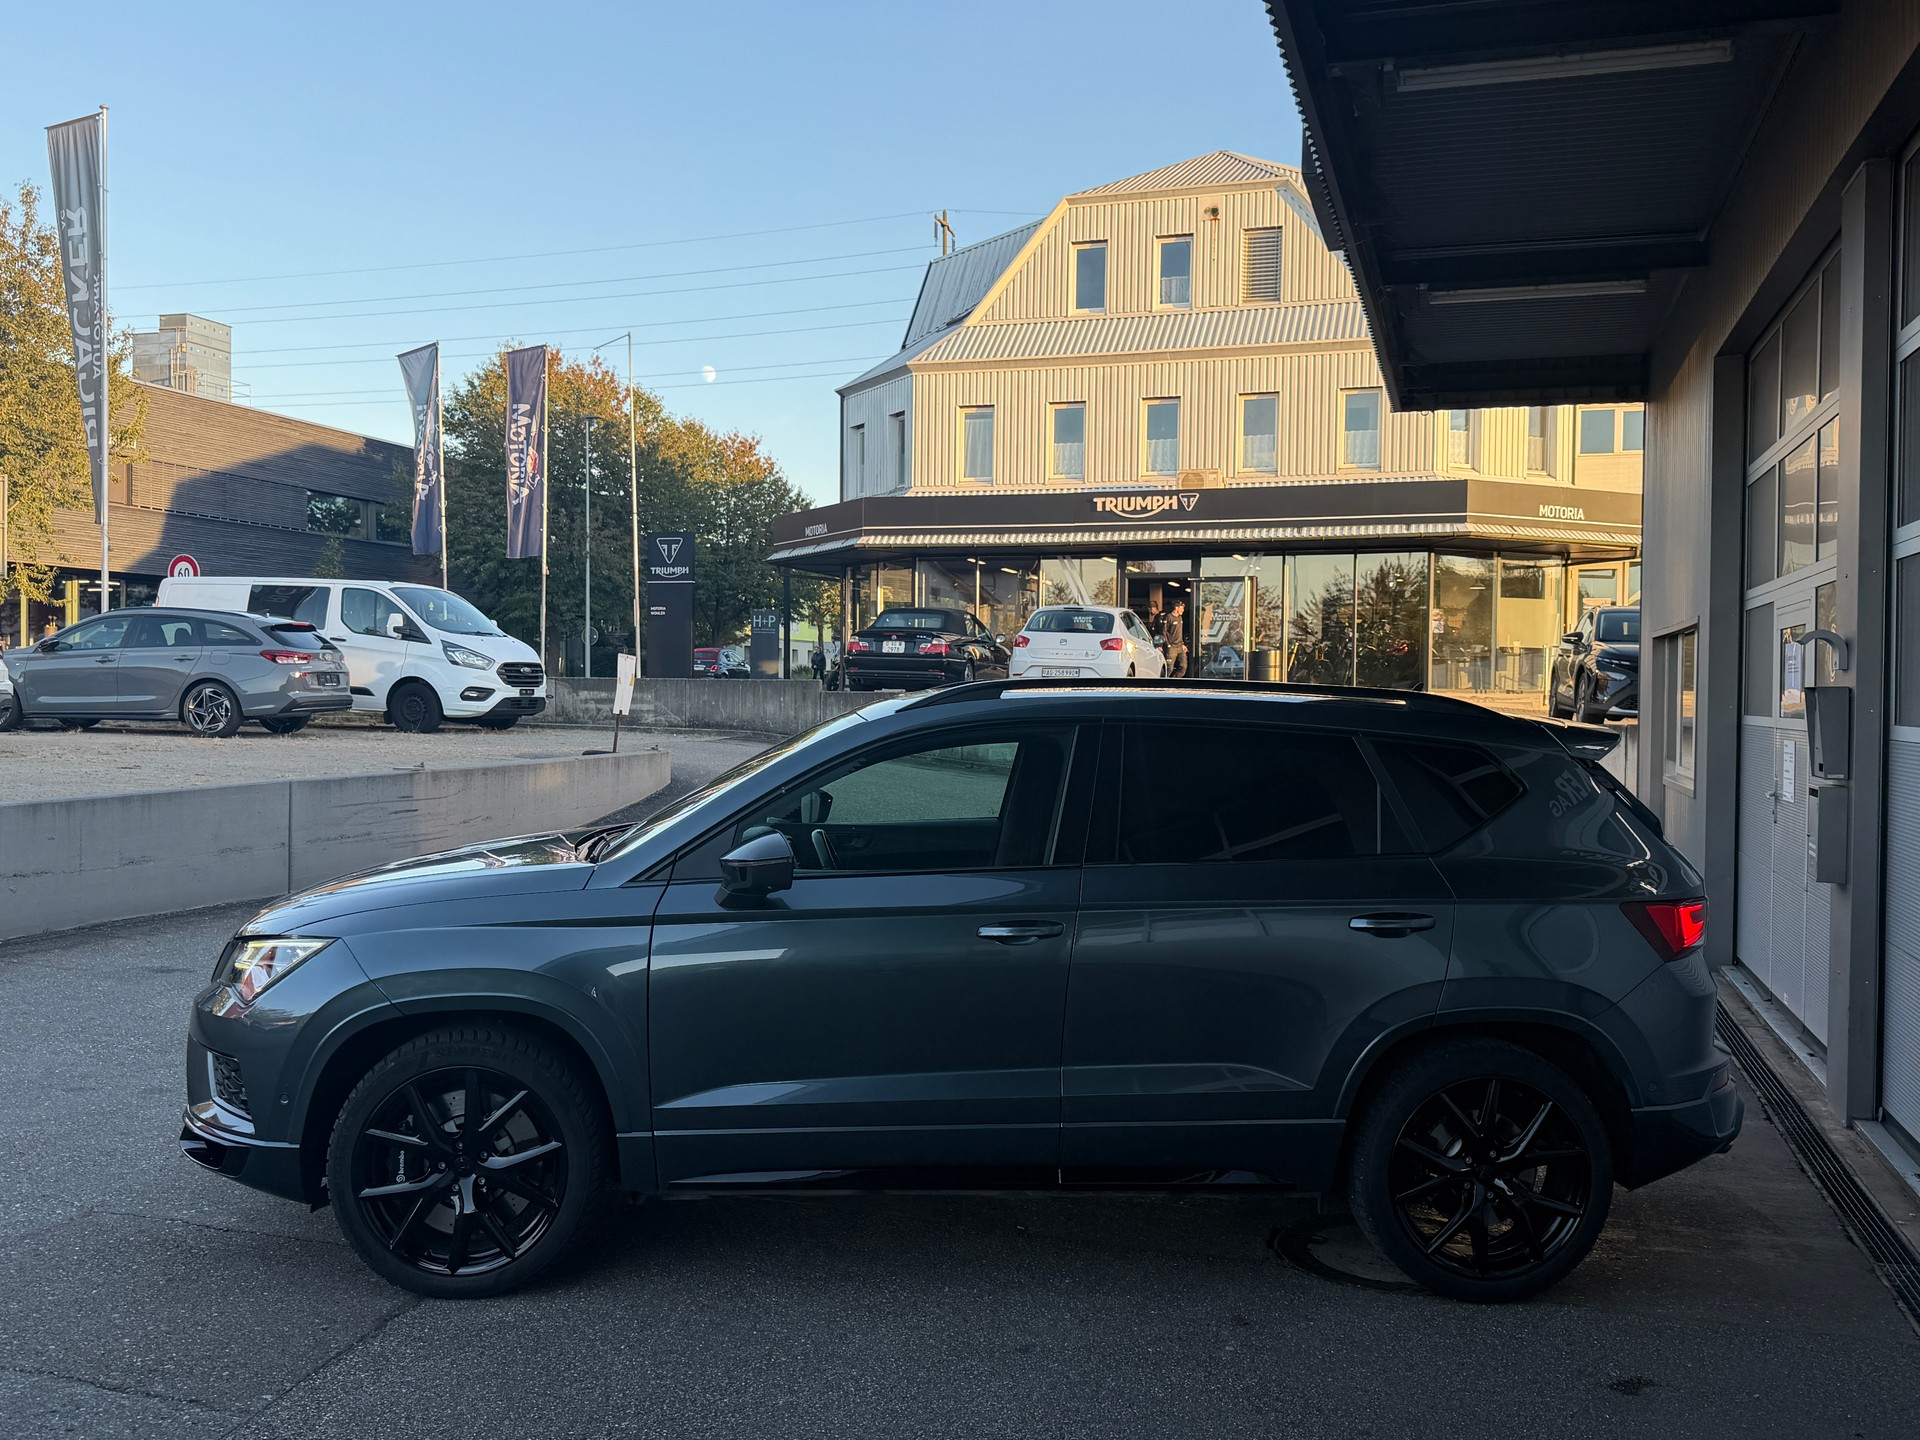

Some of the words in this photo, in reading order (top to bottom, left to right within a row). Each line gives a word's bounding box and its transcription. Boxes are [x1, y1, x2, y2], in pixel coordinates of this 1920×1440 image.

[509, 403, 532, 505] MOTORIA
[1093, 495, 1178, 518] TRIUMPH
[1538, 504, 1585, 520] MOTORIA
[804, 522, 828, 537] MOTORIA
[177, 567, 190, 577] 60
[650, 566, 689, 578] TRIUMPH
[753, 615, 776, 628] H+P
